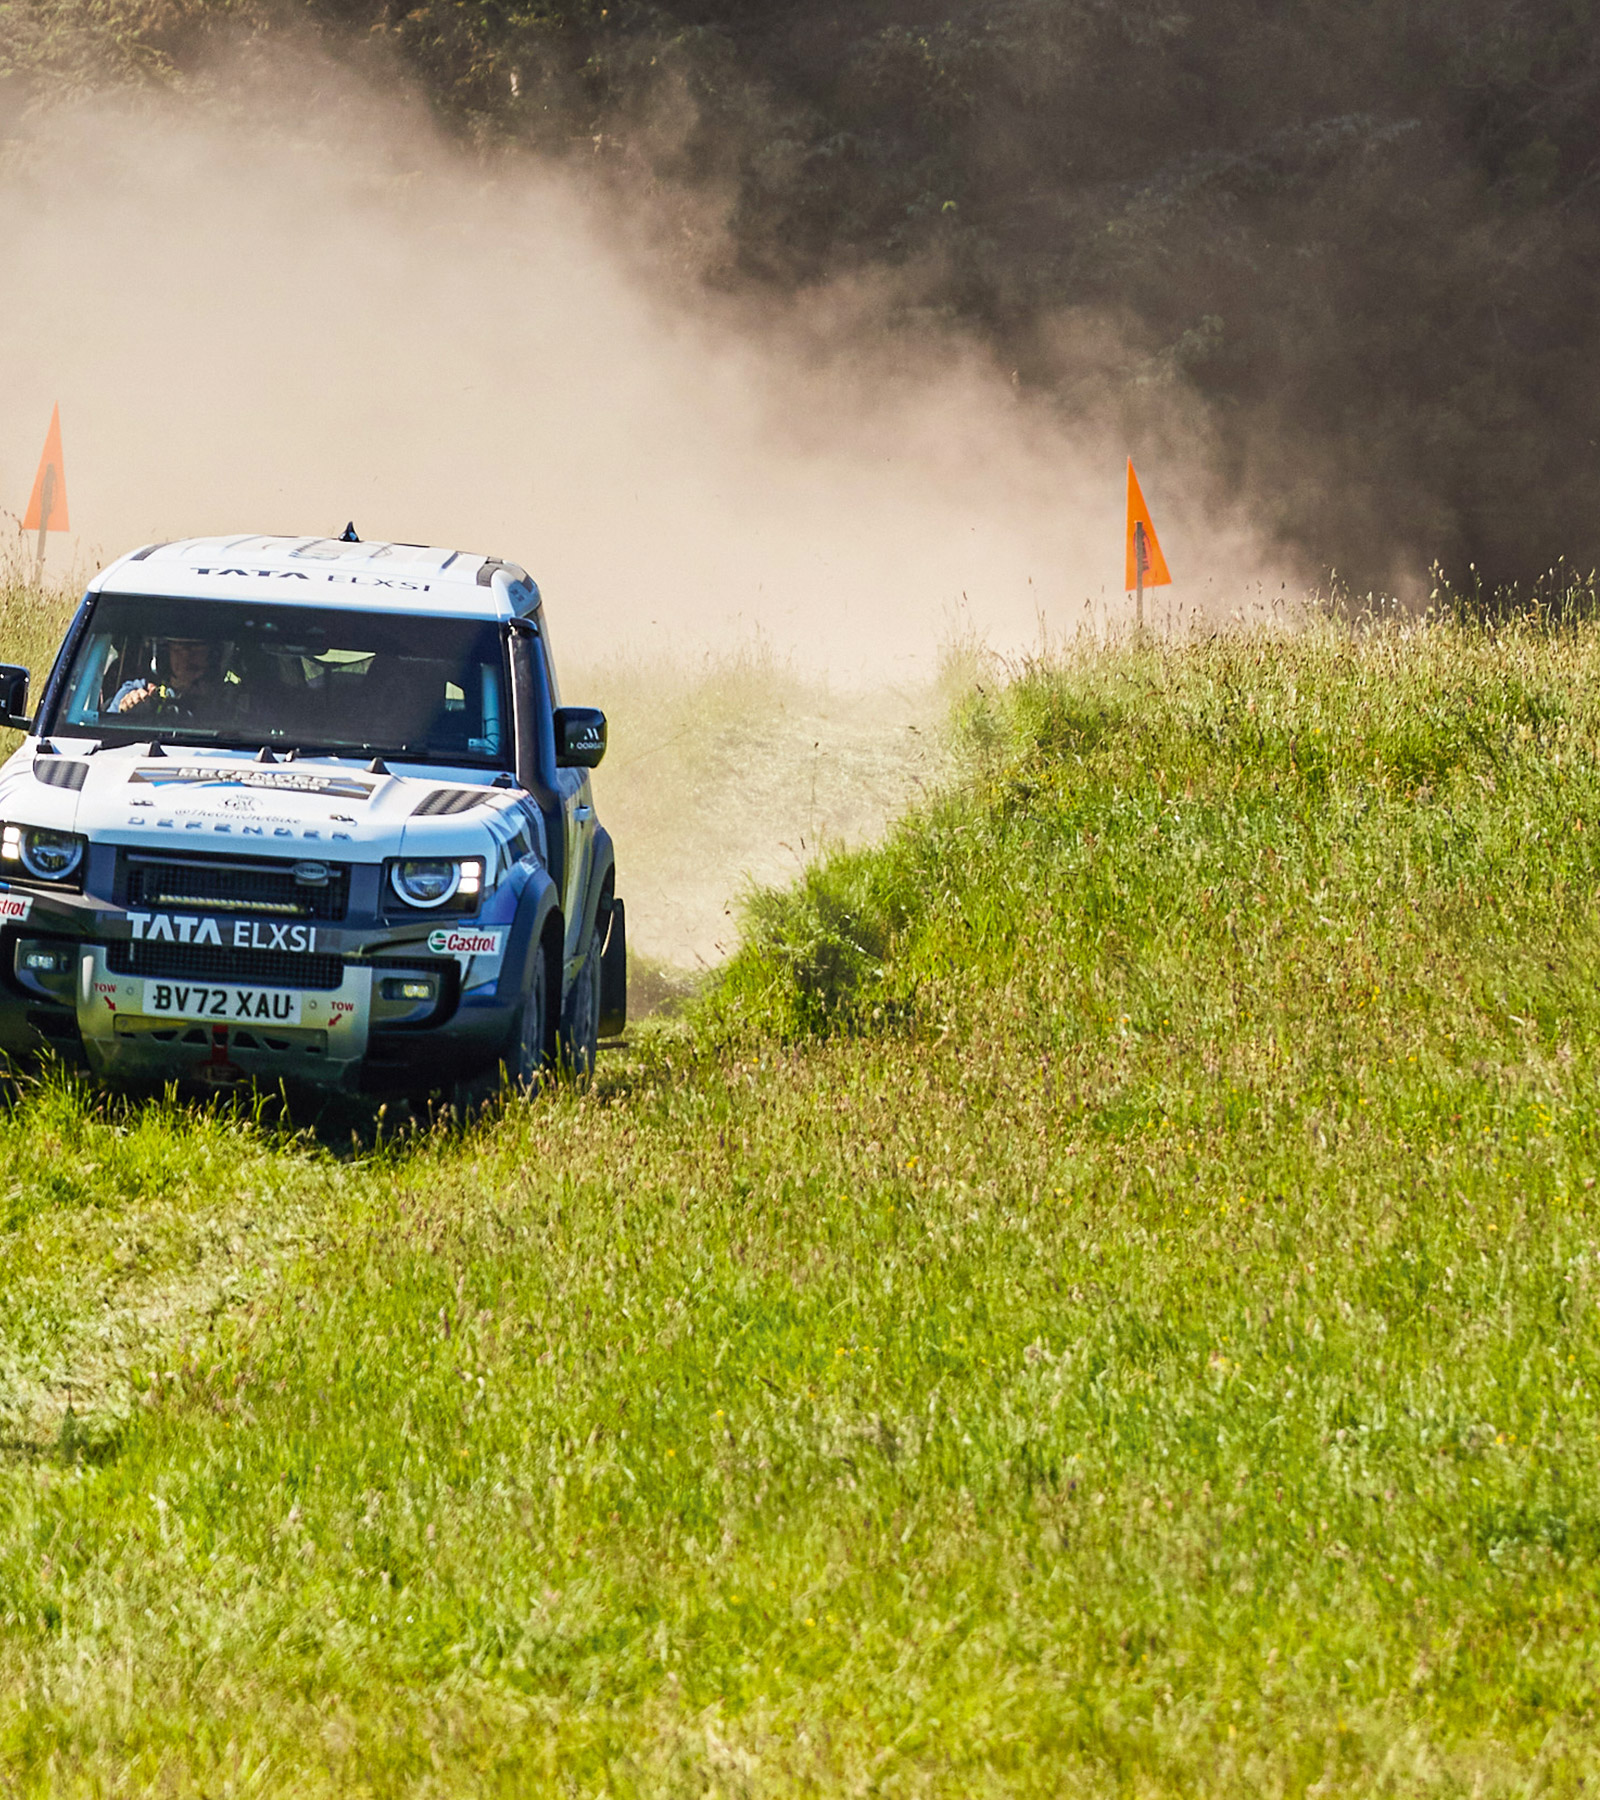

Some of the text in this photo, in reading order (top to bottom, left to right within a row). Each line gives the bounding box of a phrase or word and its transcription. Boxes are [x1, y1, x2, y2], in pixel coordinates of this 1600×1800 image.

[189, 567, 431, 592] TATA ELXSI
[127, 816, 352, 841] DEFENDER
[126, 911, 316, 953] TATA ELXSI
[447, 933, 496, 952] Castrol
[94, 982, 117, 993] TOW
[154, 984, 291, 1019] BV72 XAU
[331, 1000, 355, 1012] TOW
